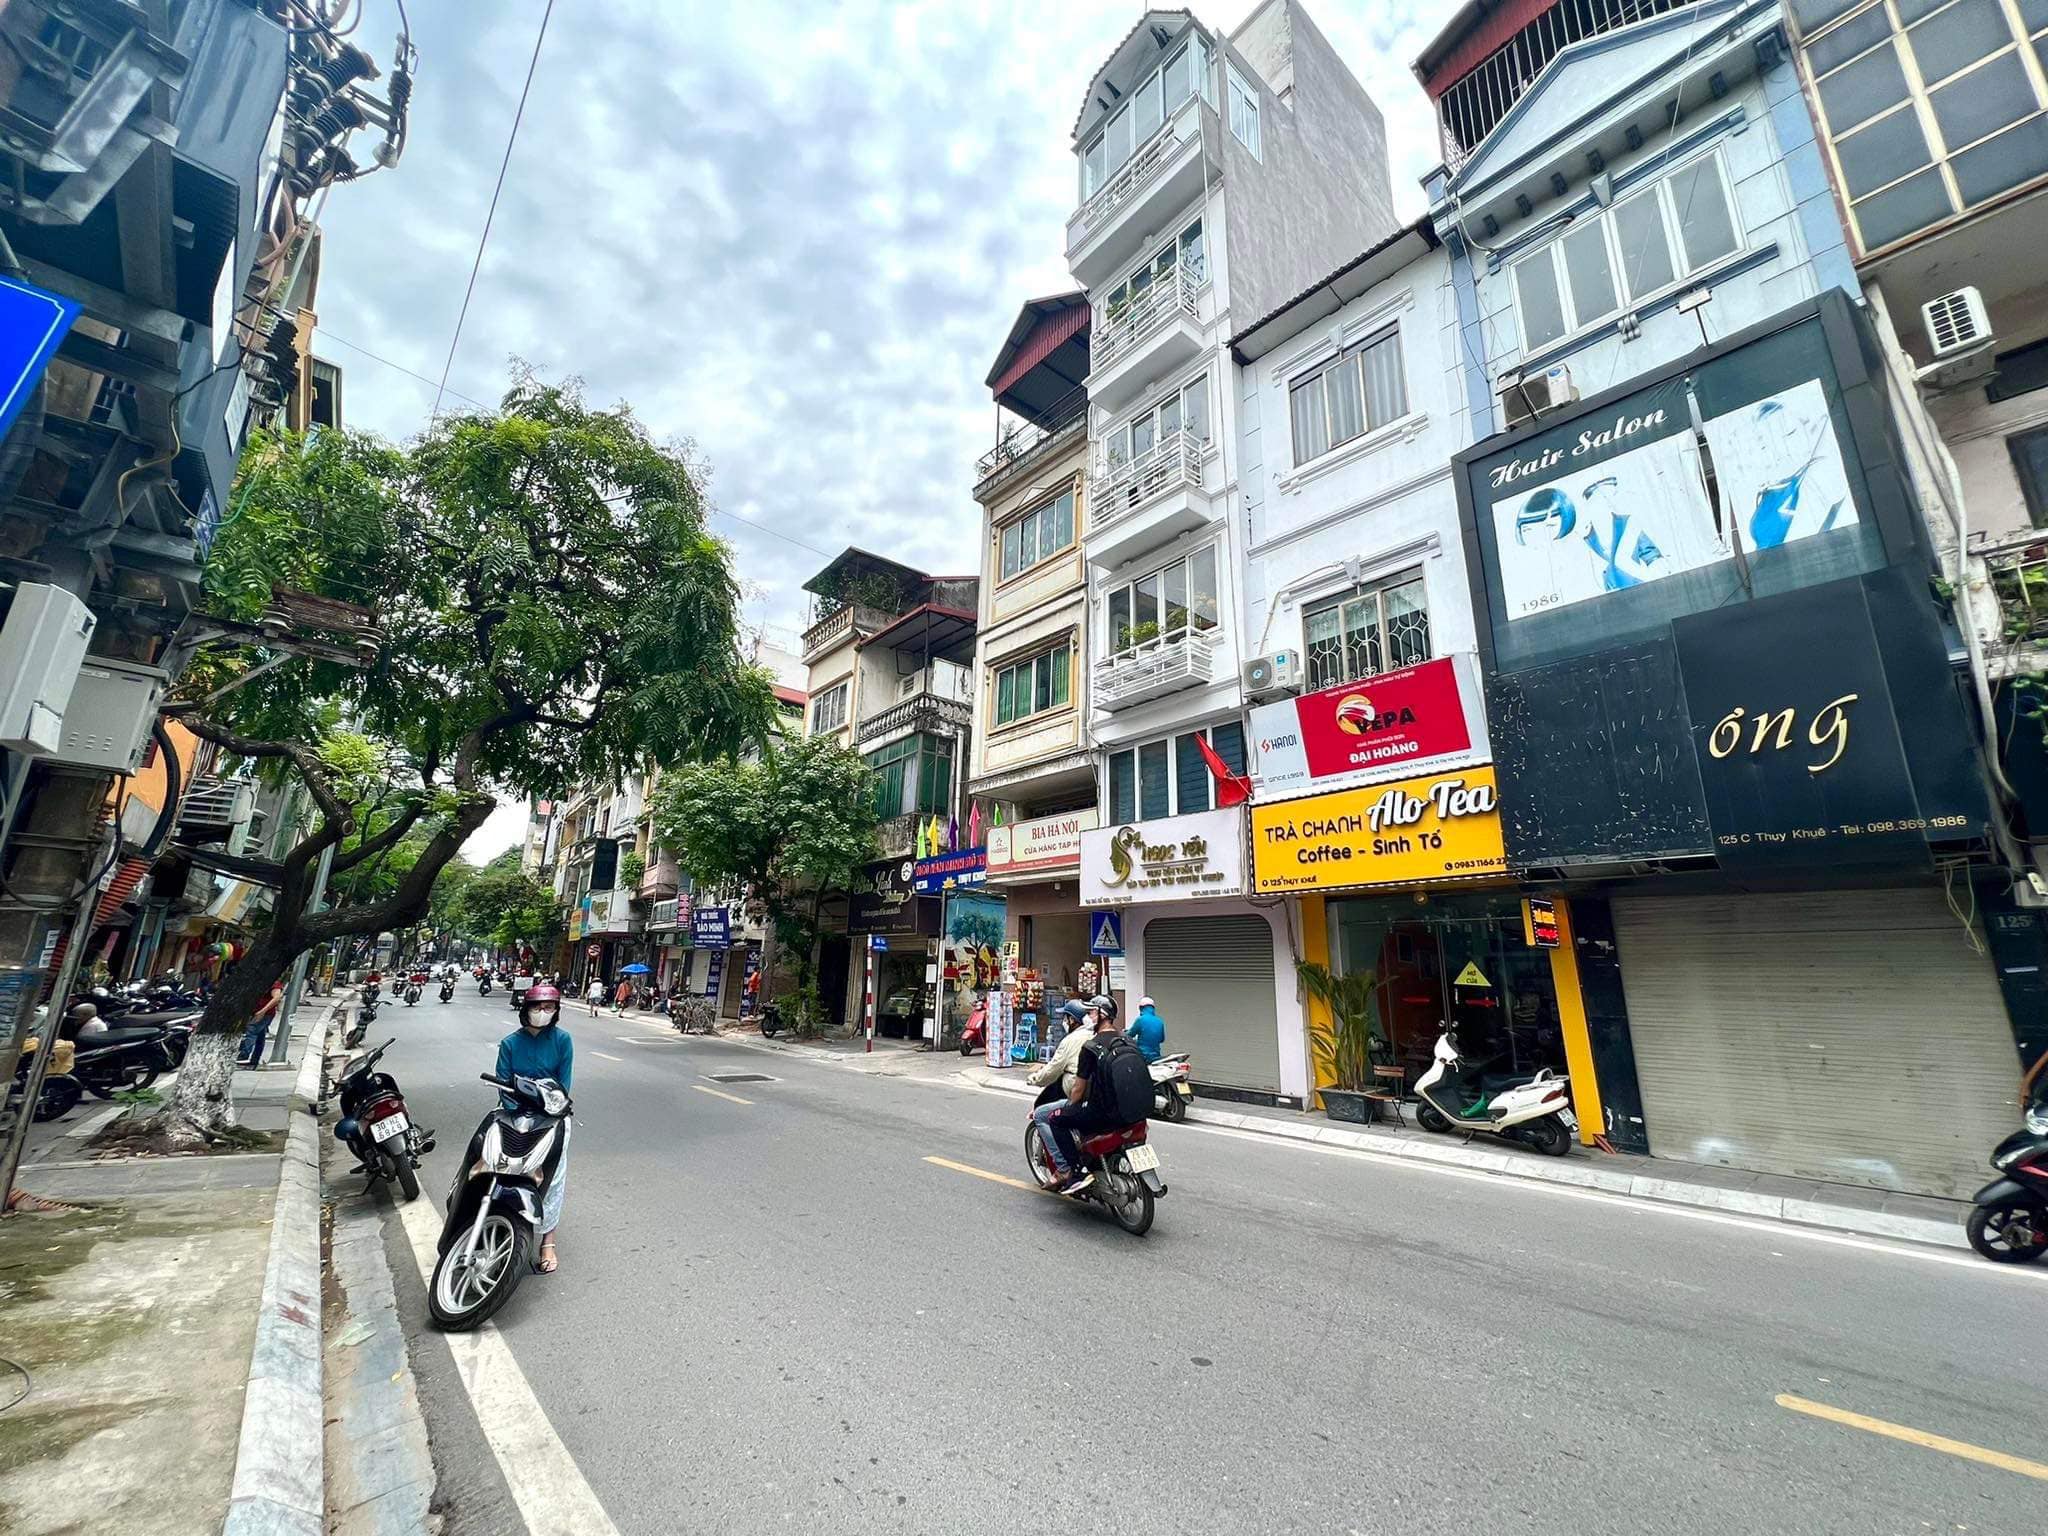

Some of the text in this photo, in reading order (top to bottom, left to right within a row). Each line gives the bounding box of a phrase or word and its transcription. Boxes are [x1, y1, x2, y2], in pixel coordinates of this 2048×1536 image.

[1488, 404, 1669, 488] Hair Salon
[1521, 593, 1559, 611] 1986
[1349, 741, 1419, 764] ĐẠI HOÀNG
[1264, 779, 1497, 844] TRÀ CHANH Alo Tea
[1031, 826, 1046, 840] BIA
[1062, 819, 1079, 835] NỘI
[1718, 834, 1738, 845] 125
[1740, 833, 1751, 844] C
[1792, 827, 1827, 840] Khuê
[1840, 824, 1865, 836] Tel:
[1867, 815, 1967, 833] 098.369.1986
[1297, 844, 1353, 864] Coffee
[1373, 836, 1411, 856] Sinh
[1418, 829, 1443, 850] Tố
[1997, 915, 2032, 929] 125
